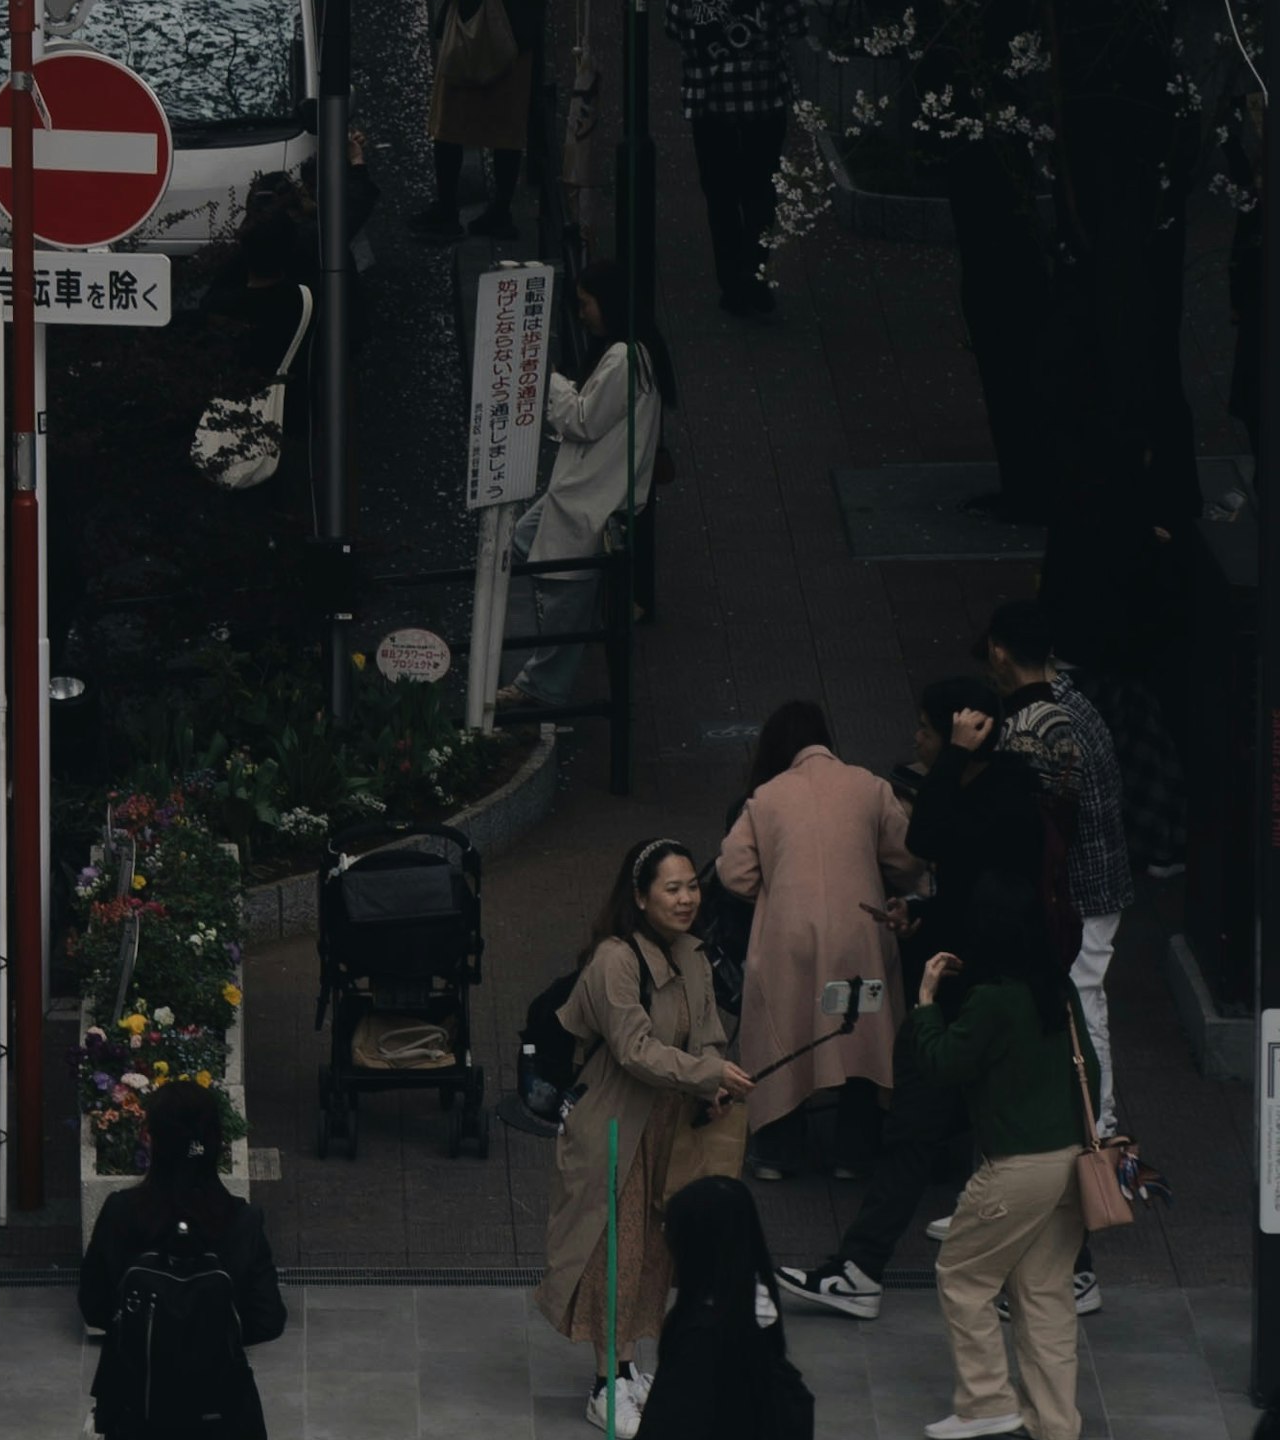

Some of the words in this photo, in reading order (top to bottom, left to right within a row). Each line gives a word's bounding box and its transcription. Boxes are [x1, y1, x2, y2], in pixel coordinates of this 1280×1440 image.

[486, 278, 518, 500] 妨げとならないよう通行しましょう
[515, 276, 546, 427] 自転車は歩行者の通行の
